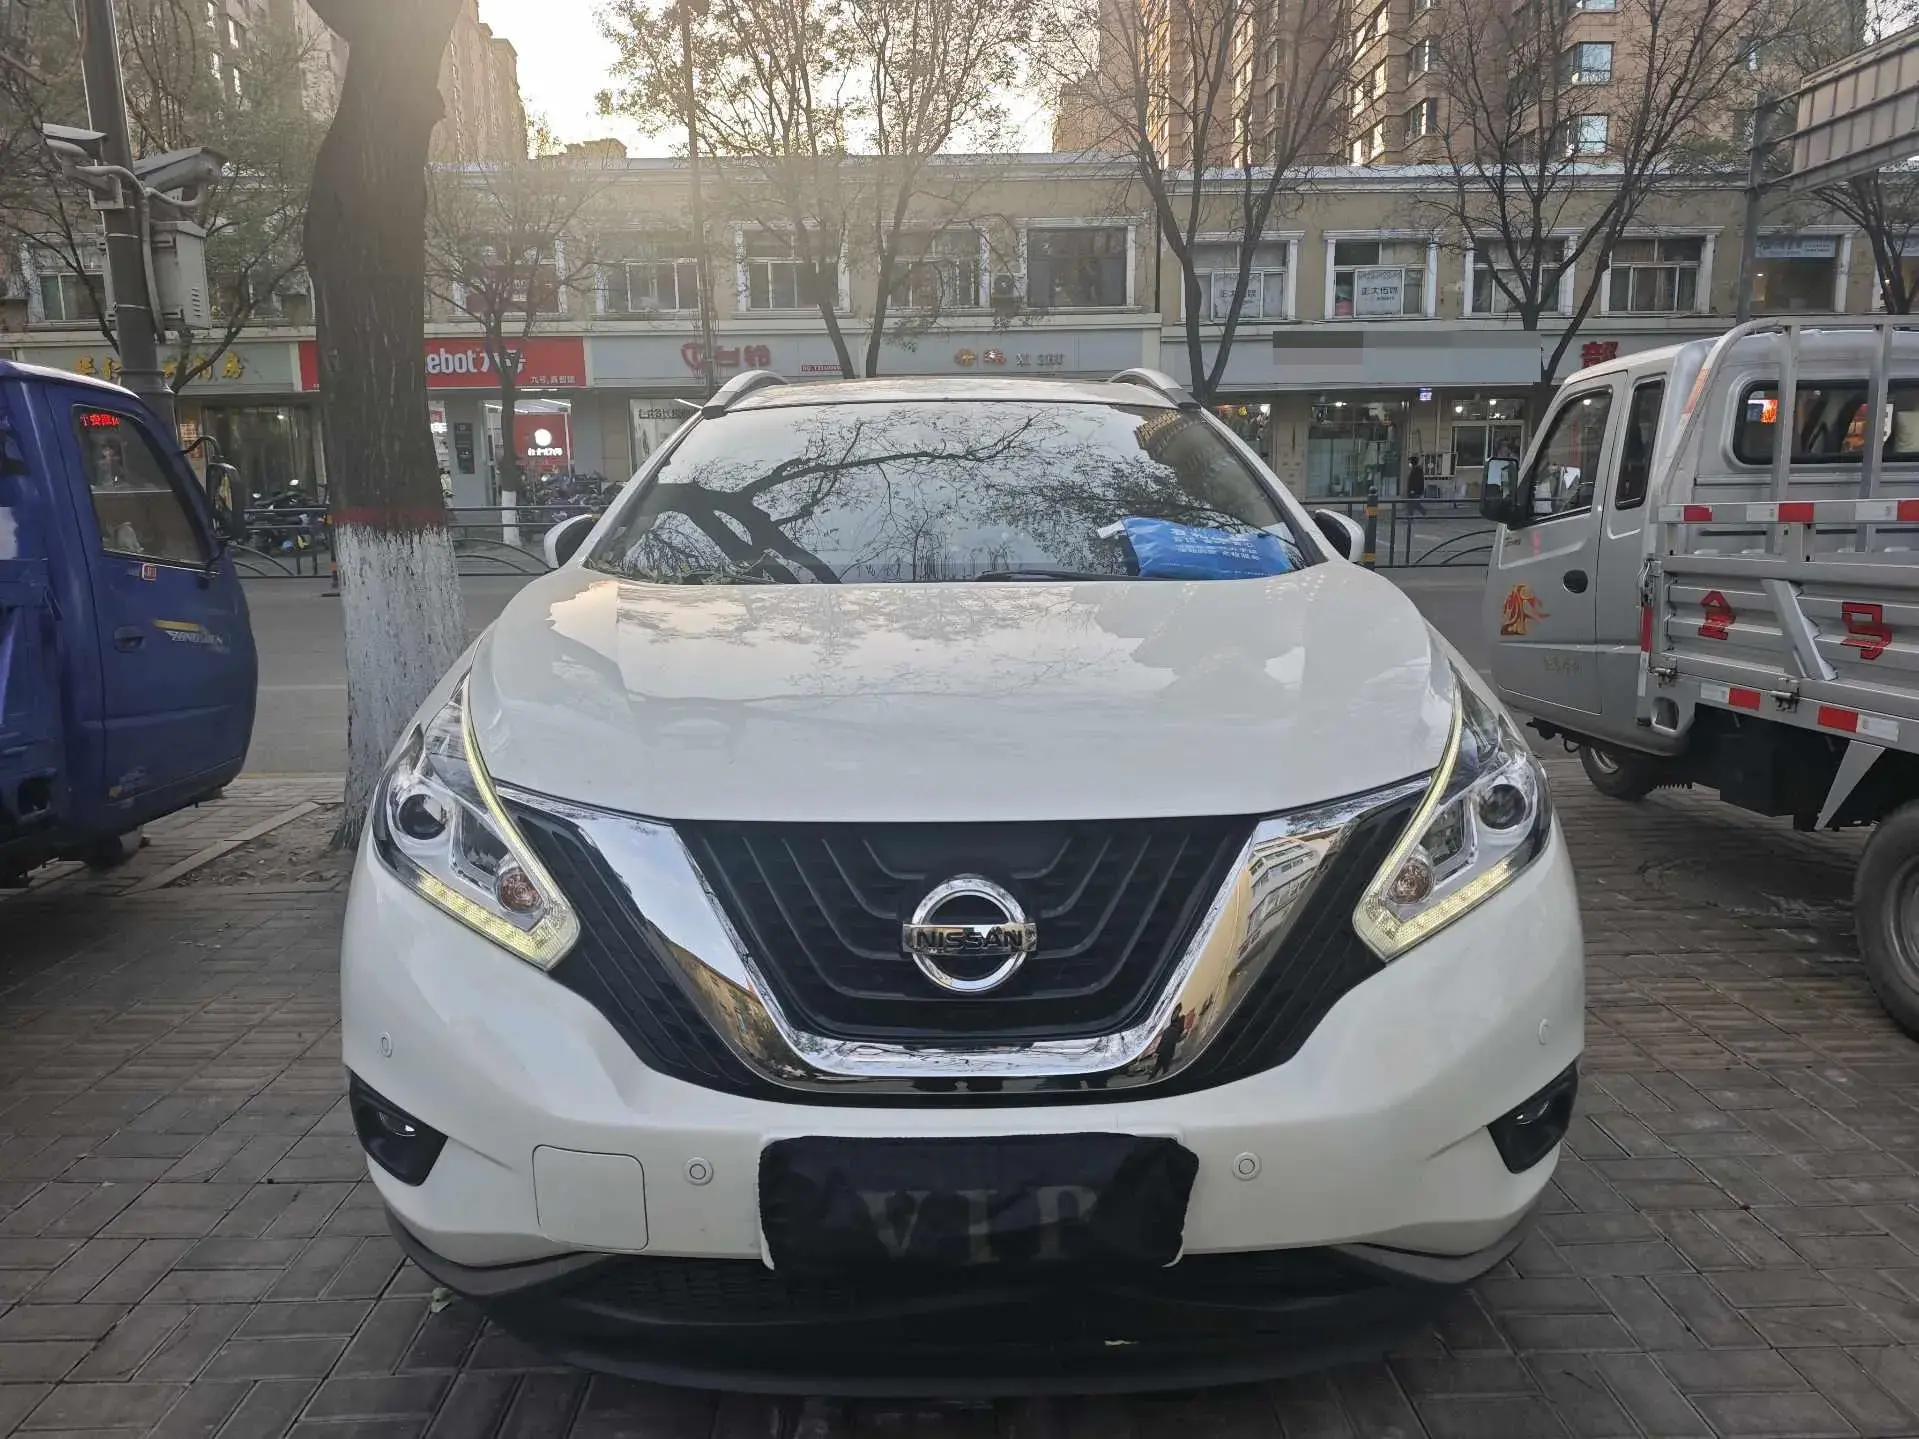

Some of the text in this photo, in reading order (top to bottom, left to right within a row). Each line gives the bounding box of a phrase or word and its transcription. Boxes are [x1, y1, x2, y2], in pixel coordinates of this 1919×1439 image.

[424, 348, 477, 374] ebot
[914, 928, 1024, 949] NISSAN
[863, 1186, 1097, 1263] VIP
